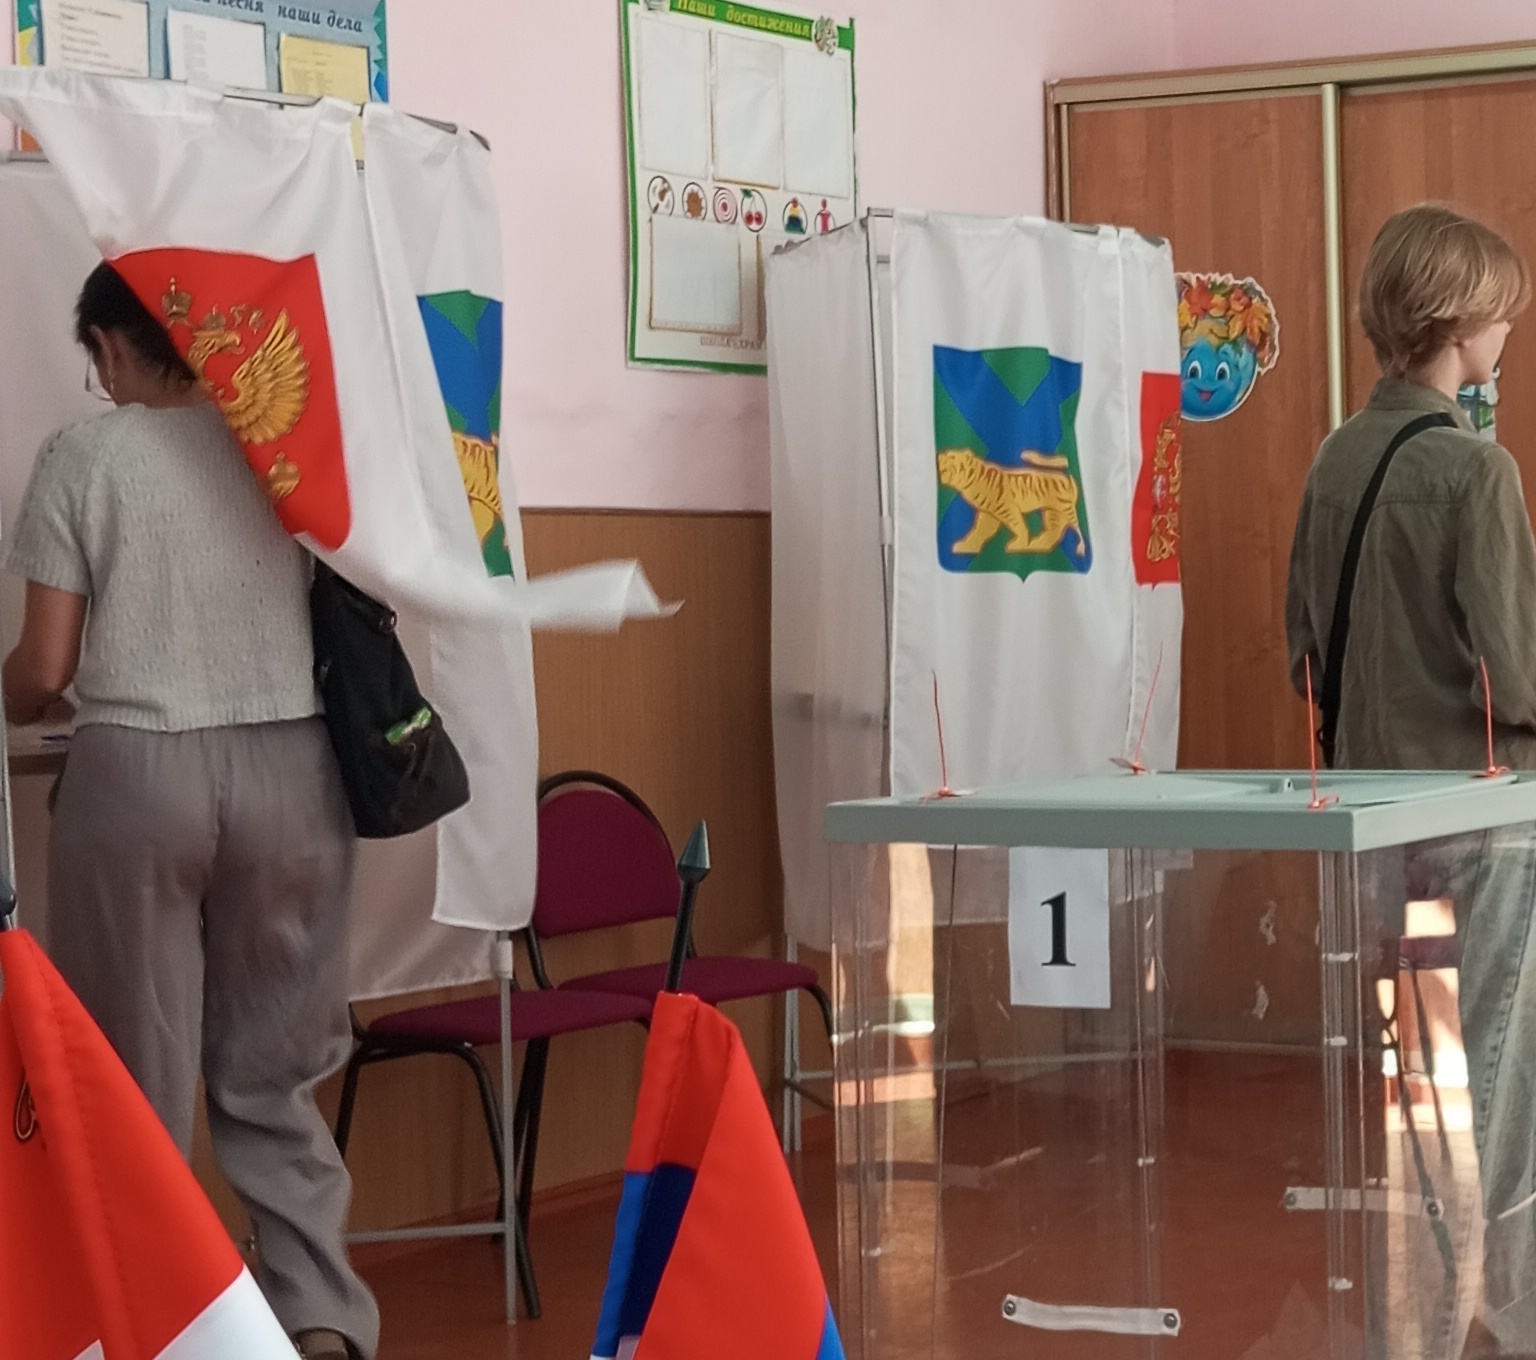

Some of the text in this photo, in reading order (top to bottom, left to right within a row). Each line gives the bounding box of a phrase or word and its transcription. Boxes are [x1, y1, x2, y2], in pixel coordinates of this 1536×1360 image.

[277, 3, 363, 33] наши дела
[726, 4, 810, 36] достижения
[1040, 891, 1077, 967] 1
